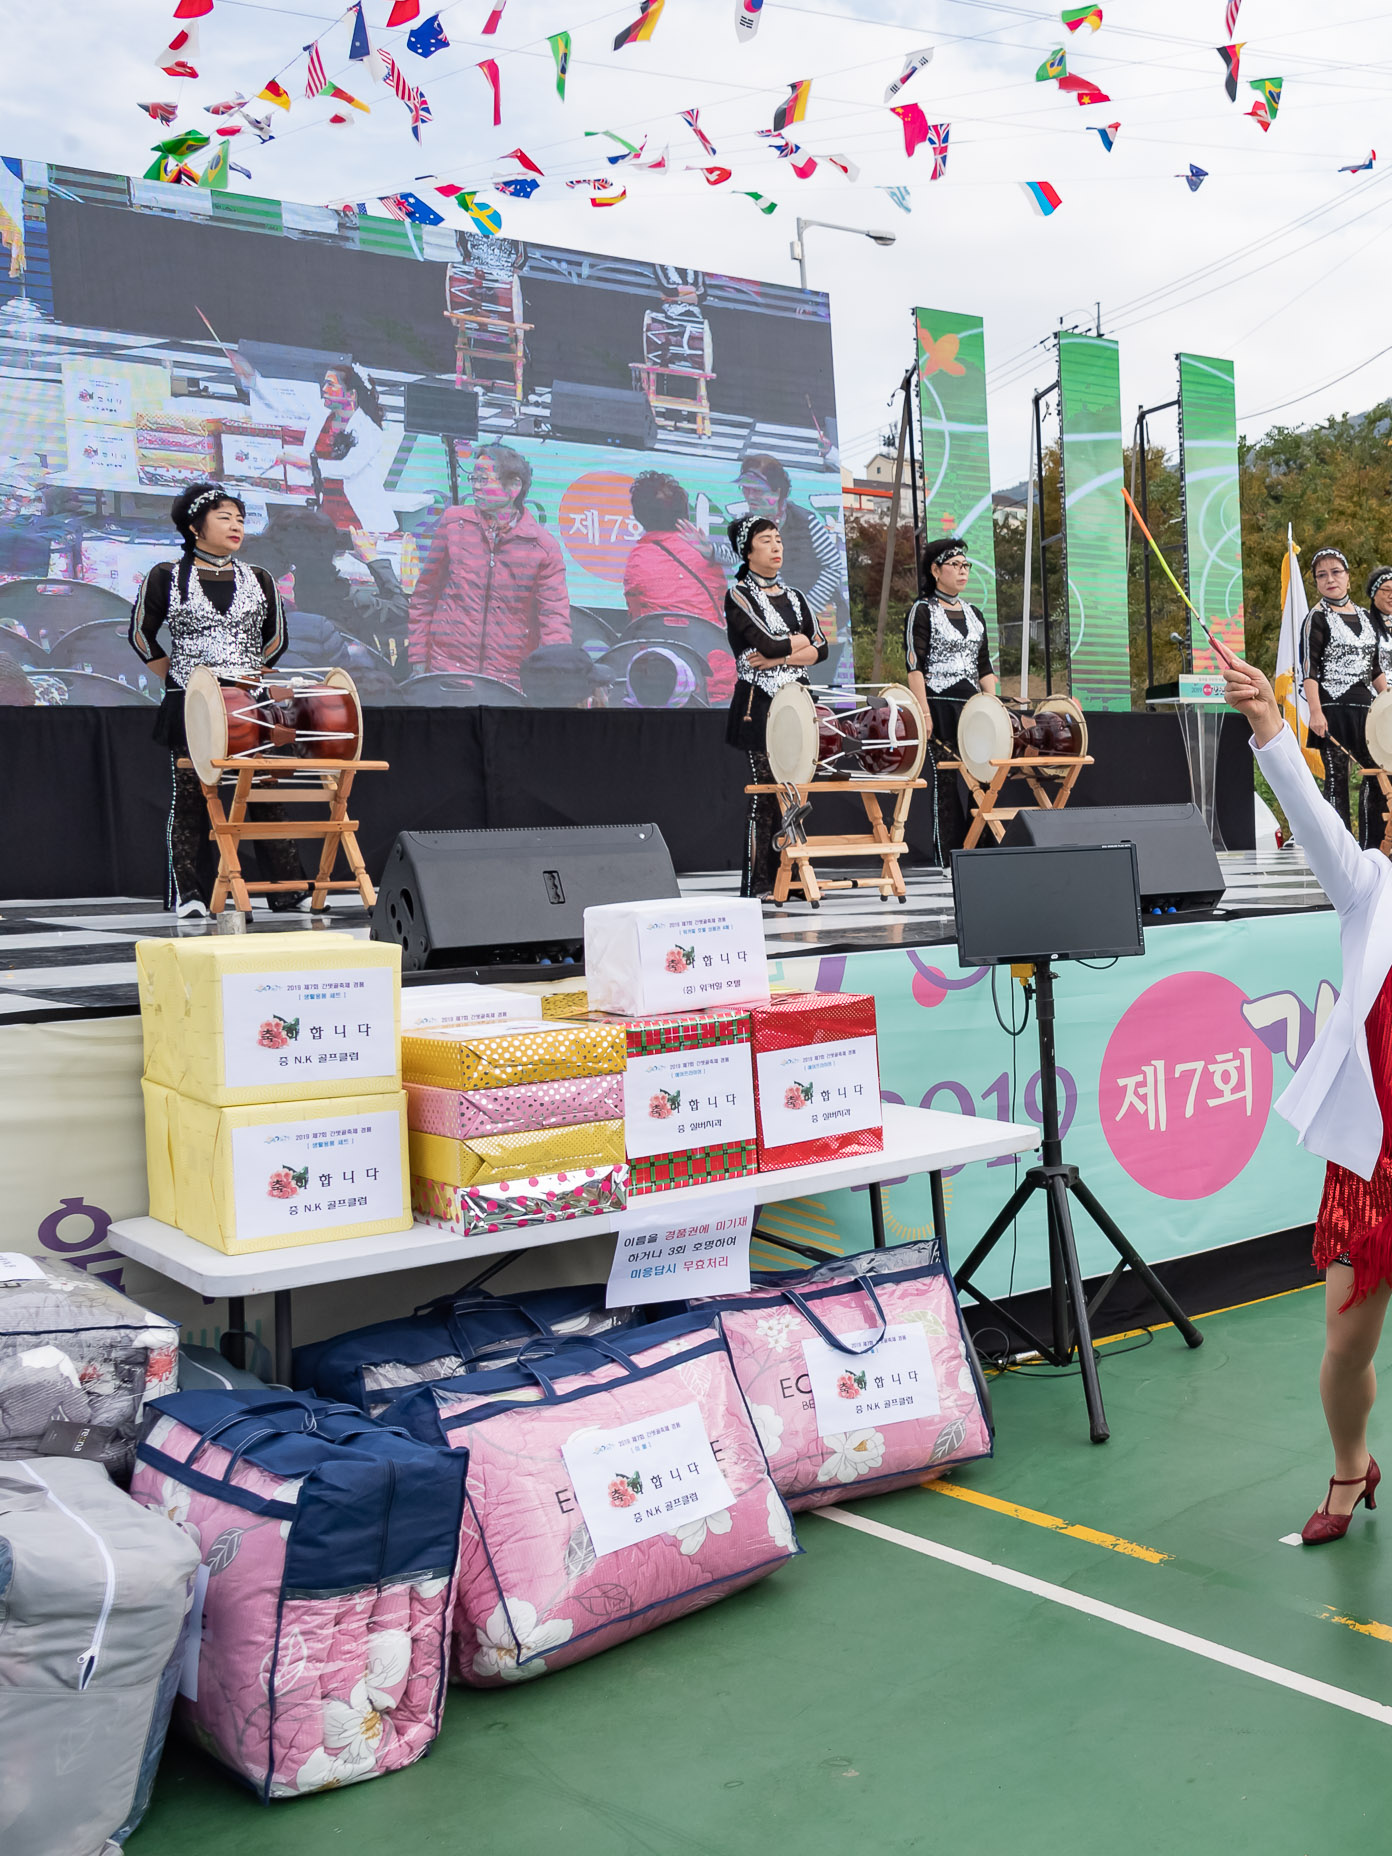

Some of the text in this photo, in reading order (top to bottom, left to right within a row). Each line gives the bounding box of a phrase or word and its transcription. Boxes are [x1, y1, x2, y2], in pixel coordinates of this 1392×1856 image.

[294, 1055, 313, 1065] N.K
[1114, 1046, 1253, 1133] 제7회
[304, 1203, 322, 1213] N.K
[623, 1215, 748, 1248] 이름을 경품권에 미기재
[628, 1235, 737, 1263] 하거나 3회 호명하여
[630, 1255, 729, 1280] 미응답시 무효처리
[866, 1401, 881, 1411] N.K
[645, 1505, 662, 1518] N.K
